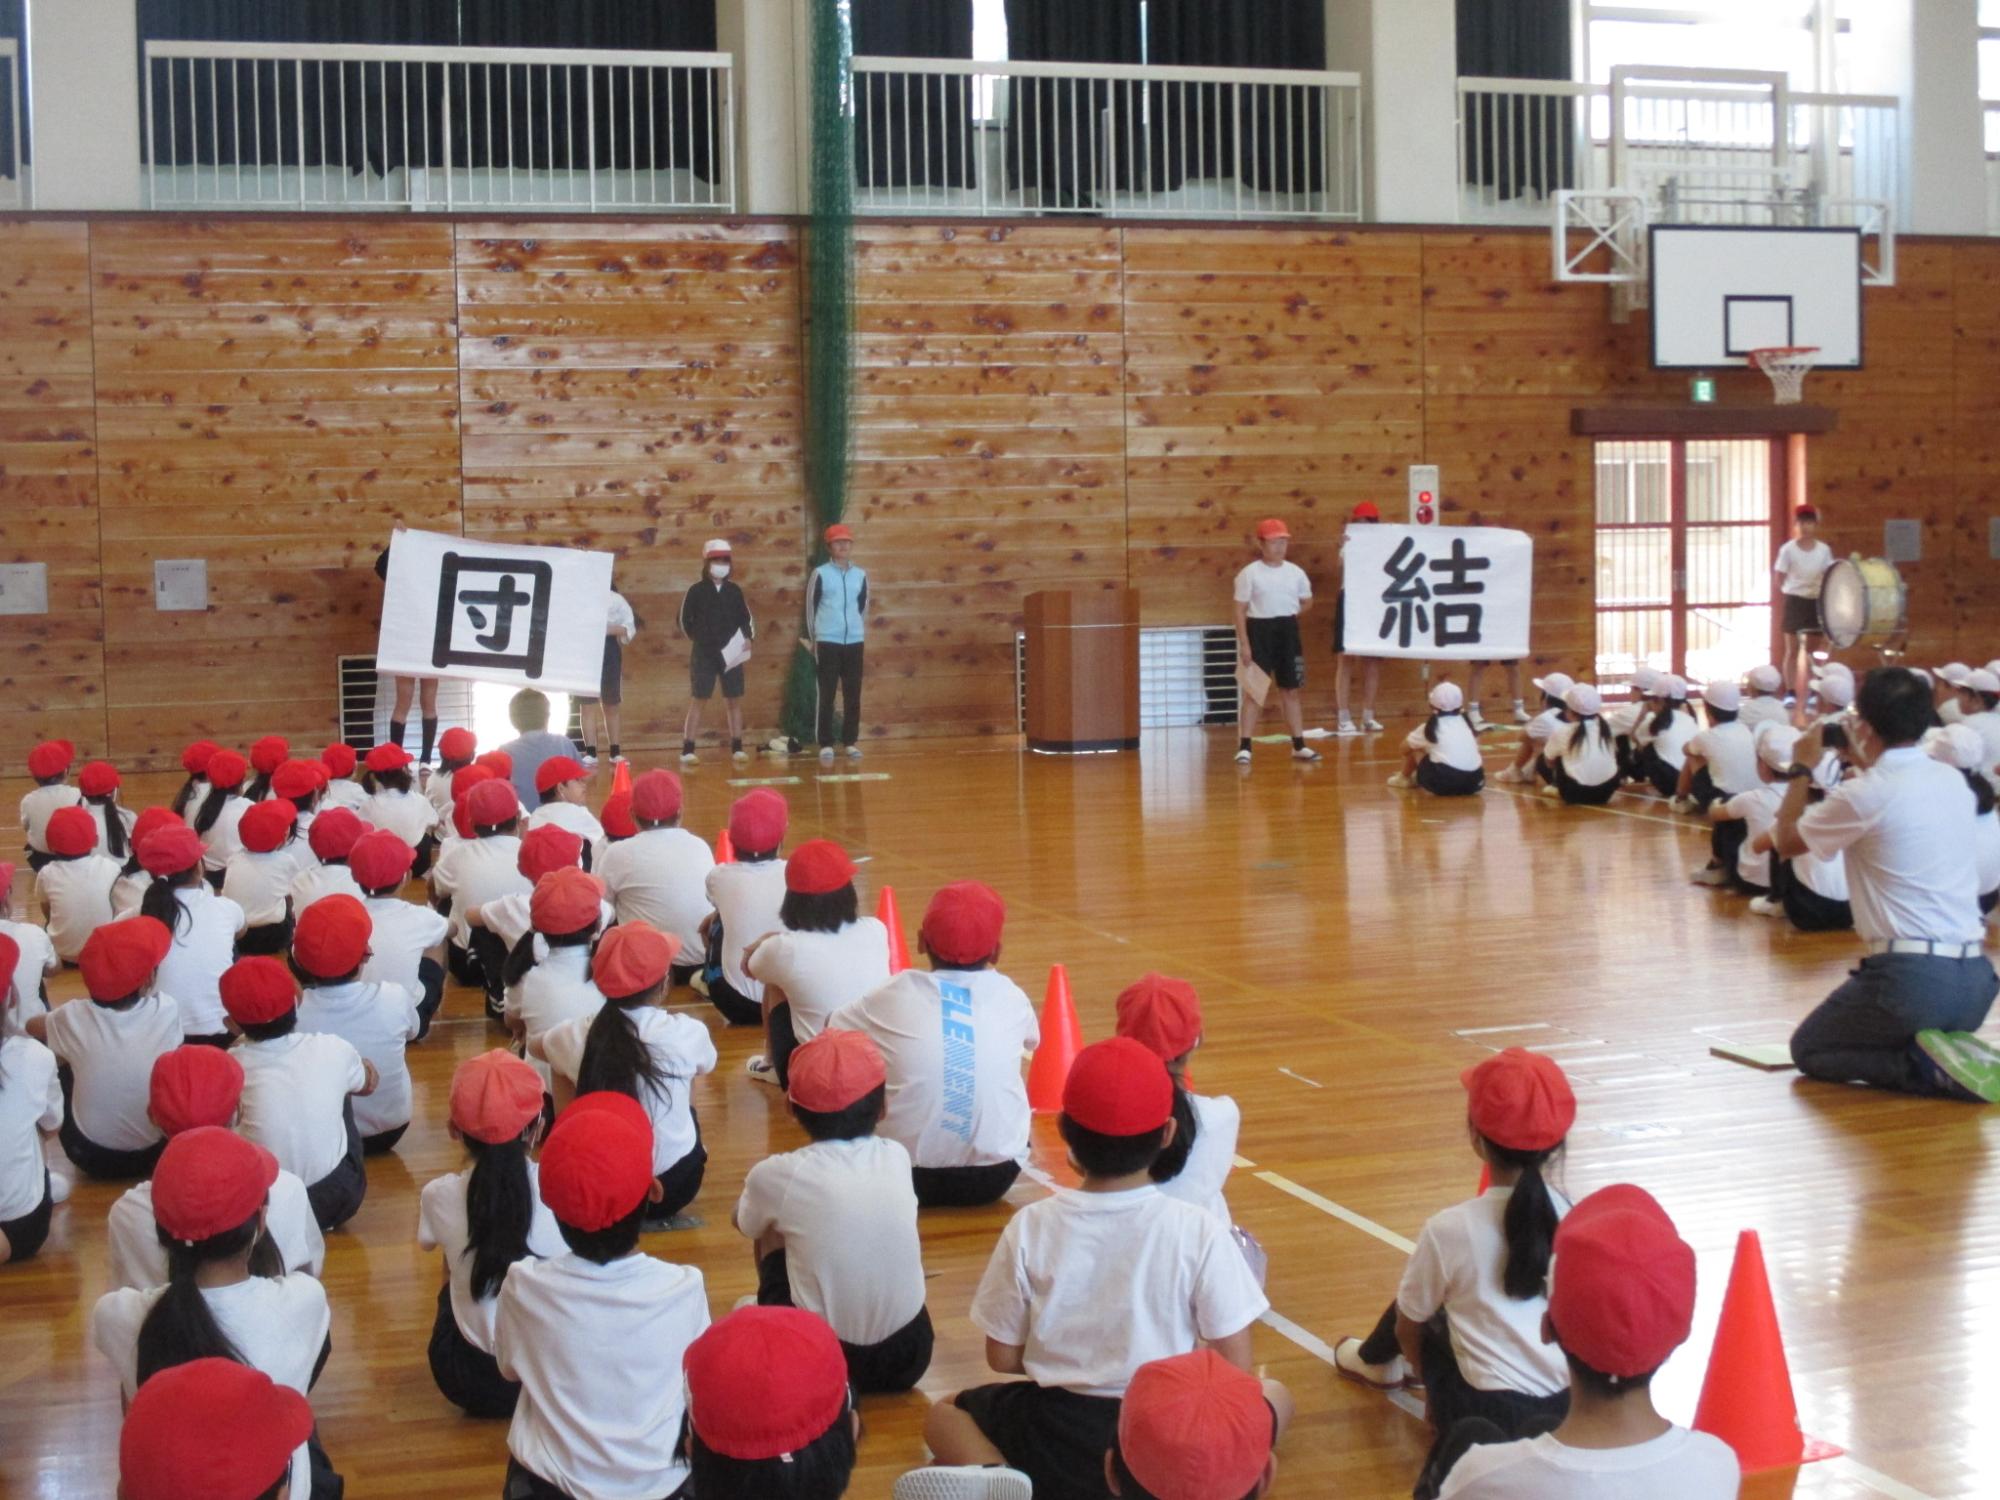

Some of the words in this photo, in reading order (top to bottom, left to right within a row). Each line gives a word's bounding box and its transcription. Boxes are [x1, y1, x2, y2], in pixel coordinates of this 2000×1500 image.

[432, 551, 553, 679] 団
[1379, 536, 1490, 648] 結
[940, 980, 976, 1142] ELEMENT
